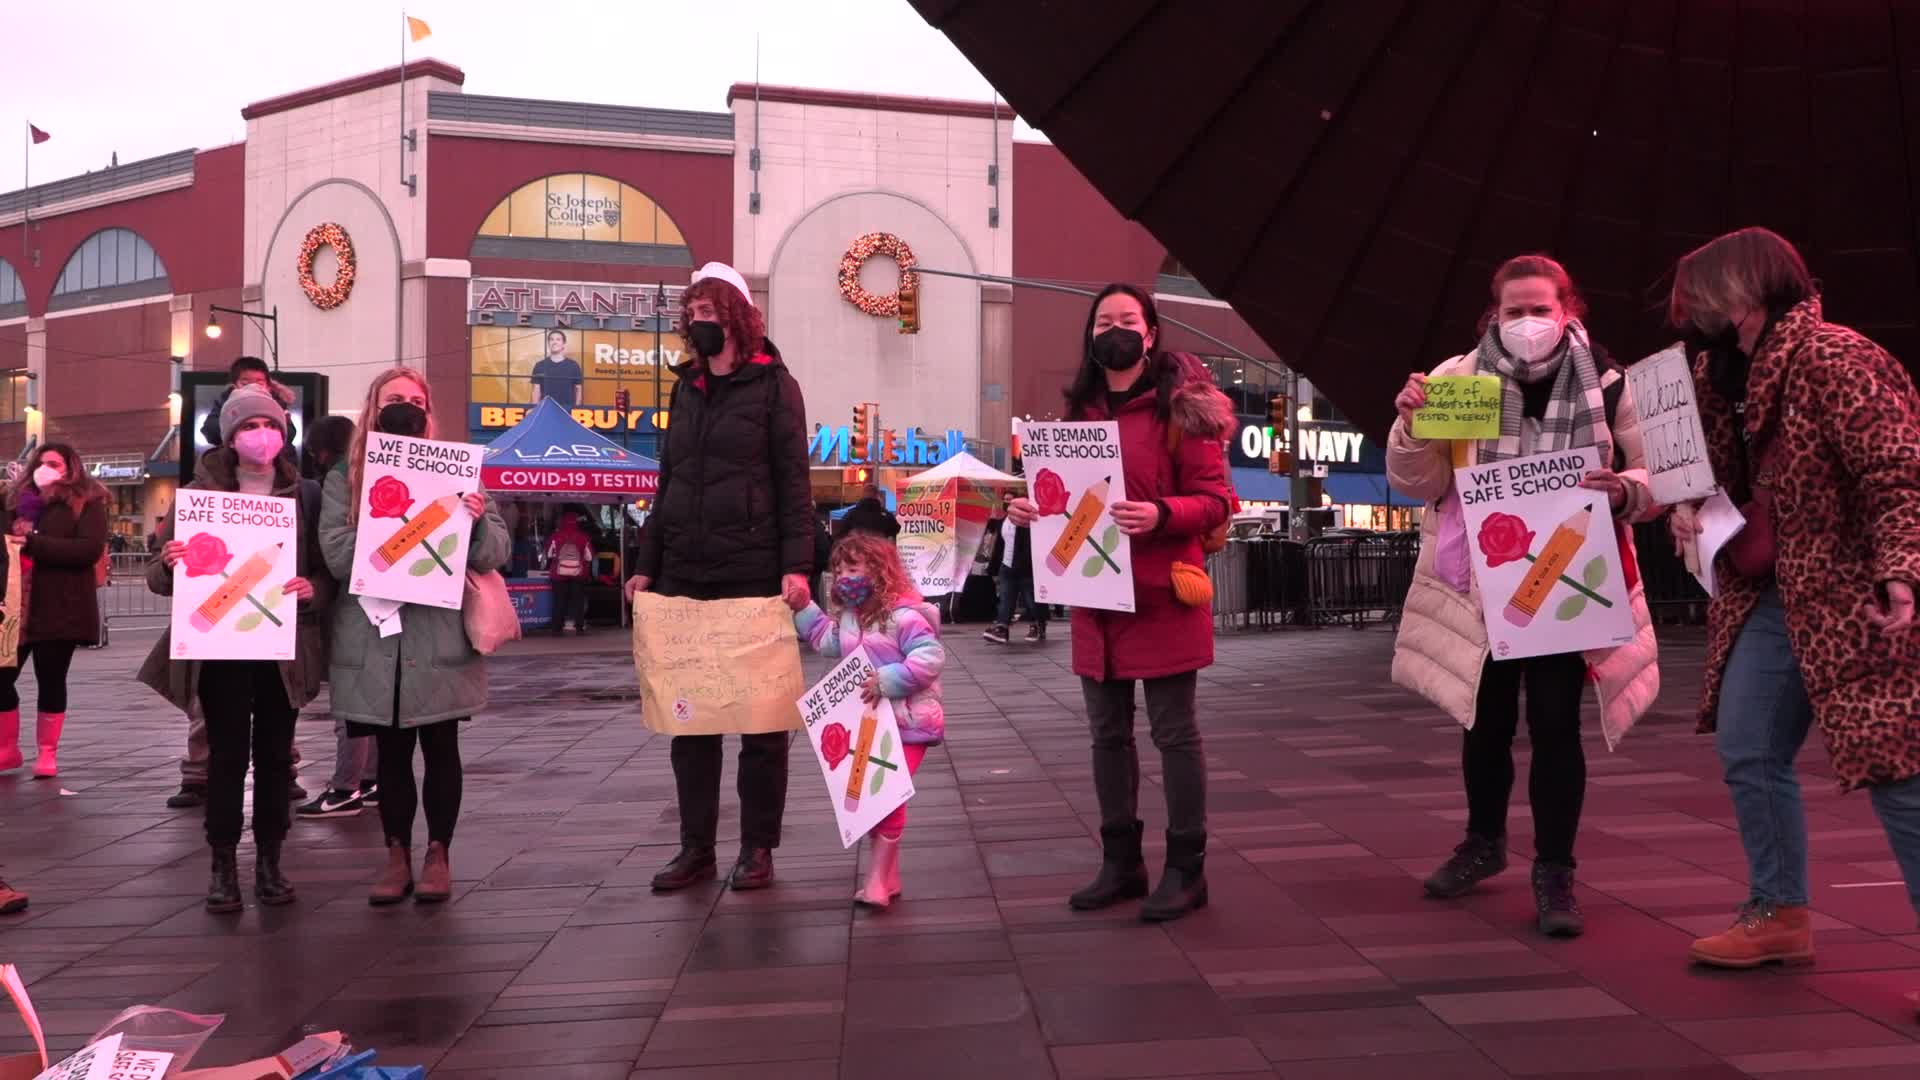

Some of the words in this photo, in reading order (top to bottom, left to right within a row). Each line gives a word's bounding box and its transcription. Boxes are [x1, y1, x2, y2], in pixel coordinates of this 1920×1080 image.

[548, 192, 562, 206] St
[548, 206, 603, 225] College
[1424, 381, 1457, 397] 00%
[1463, 380, 1481, 399] of
[481, 407, 533, 428] BE
[571, 408, 644, 430] BUY
[1027, 427, 1049, 442] WE
[1052, 427, 1108, 443] DEMAND
[378, 438, 404, 453] WE
[409, 442, 471, 463] DEMAND
[1022, 444, 1050, 458] SAFE
[1055, 444, 1119, 459] SCHOOLS!
[1299, 428, 1364, 463] NAVY
[367, 450, 402, 468] SAFE
[407, 457, 479, 479] SCHOOLS!
[1471, 468, 1502, 486] WE
[1508, 455, 1585, 481] DEMAND
[500, 471, 586, 487] COVID-19
[189, 495, 216, 509] WE
[222, 497, 284, 514] DEMAND
[1463, 485, 1505, 505] SAFE
[899, 501, 950, 517] COVID-19
[178, 509, 215, 523] SAFE
[221, 512, 295, 529] SCHOOLS!
[904, 519, 945, 534] TESTING
[804, 691, 824, 710] WE
[822, 656, 862, 694] DEMAND
[804, 704, 829, 728] SAFE
